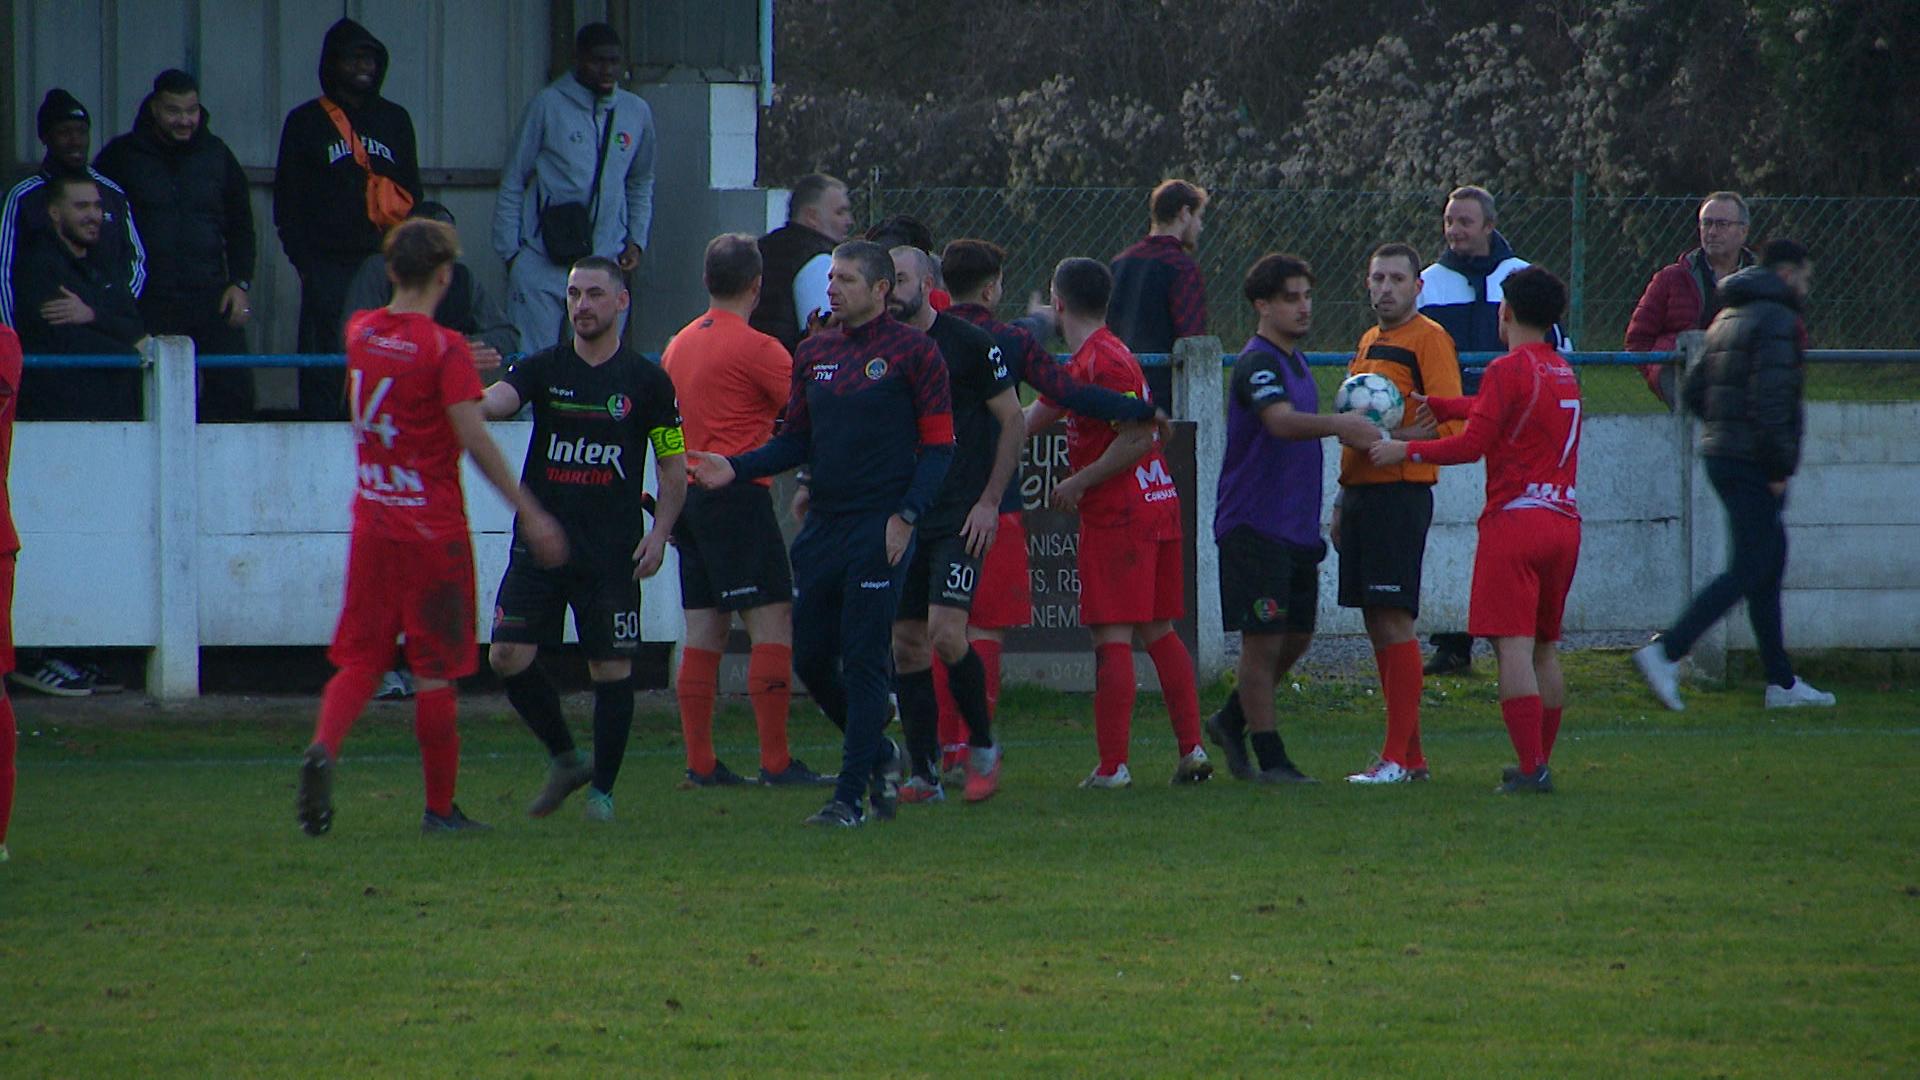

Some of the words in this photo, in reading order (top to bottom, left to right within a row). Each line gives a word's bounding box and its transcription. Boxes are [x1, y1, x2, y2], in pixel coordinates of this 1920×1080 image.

[350, 368, 400, 449] 14
[1559, 399, 1581, 469] 7
[1024, 533, 1081, 556] NISAT
[946, 562, 975, 592] 30
[613, 611, 638, 638] 50
